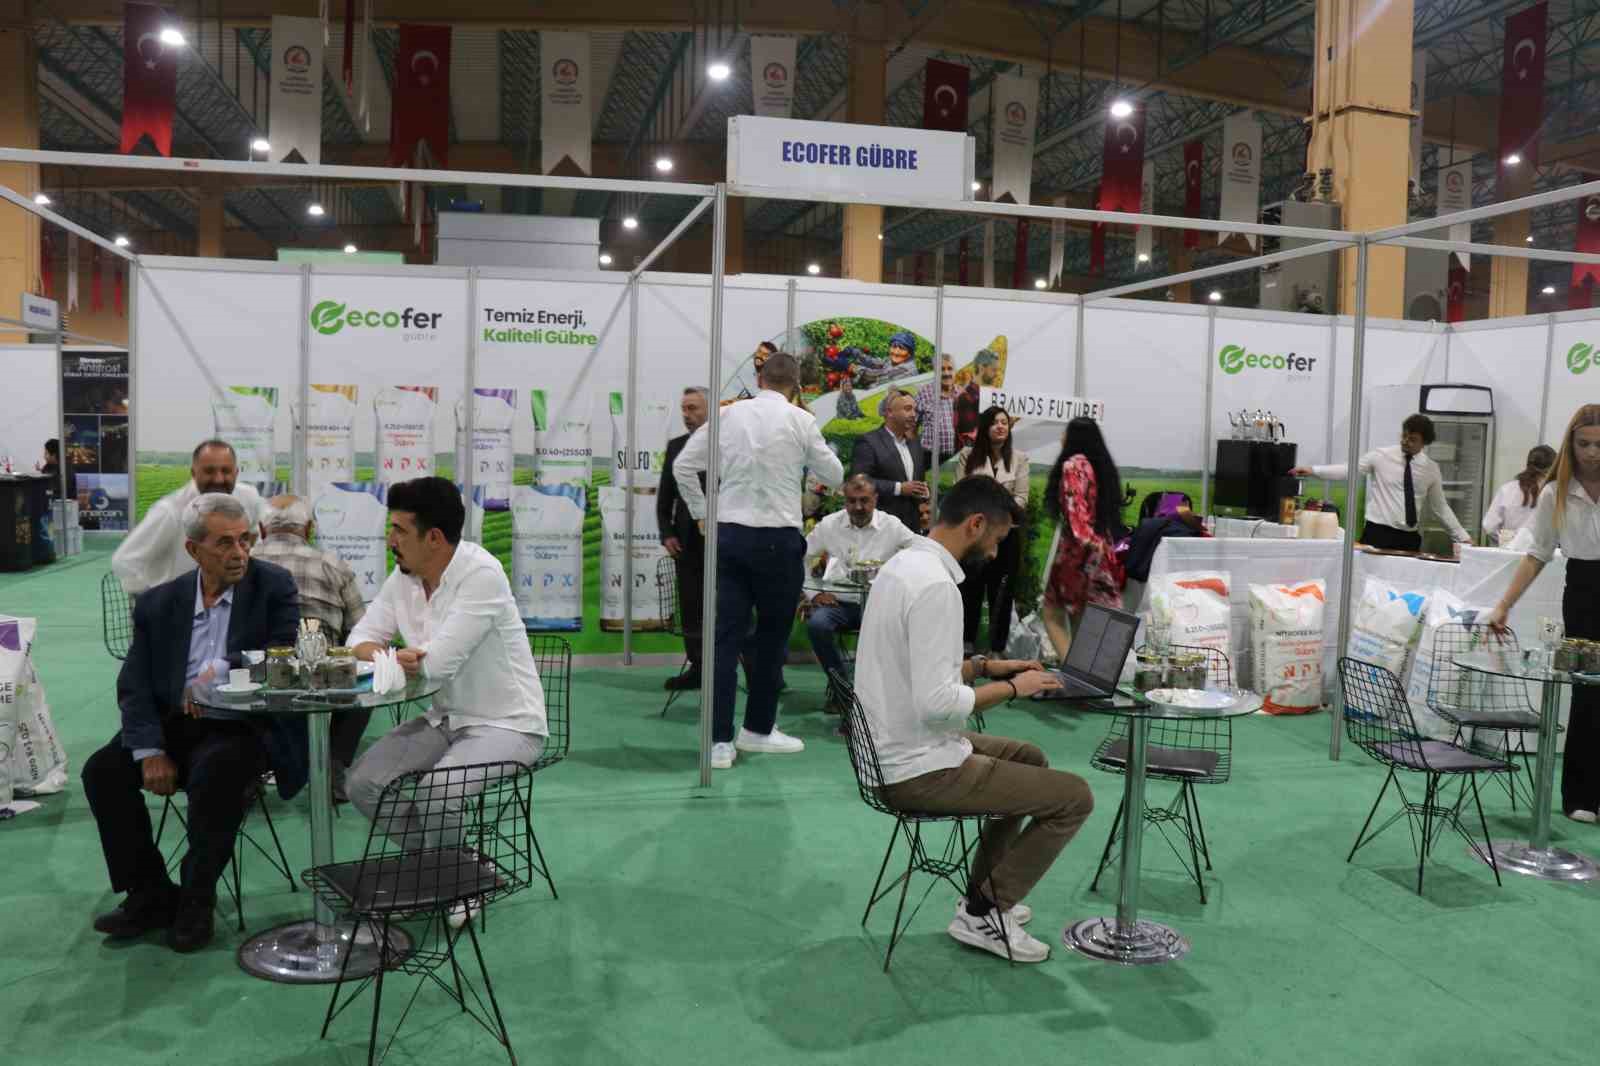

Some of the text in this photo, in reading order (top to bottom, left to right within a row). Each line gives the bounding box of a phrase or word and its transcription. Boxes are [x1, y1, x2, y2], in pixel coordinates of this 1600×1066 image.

[782, 141, 918, 169] ECOFER GÜBRE
[347, 307, 442, 329] ecofer
[484, 308, 586, 329] Temiz Enerji,
[483, 327, 597, 345] Kaliteli Gübre
[1246, 352, 1316, 371] ecofer
[1049, 399, 1098, 418] FUTURE
